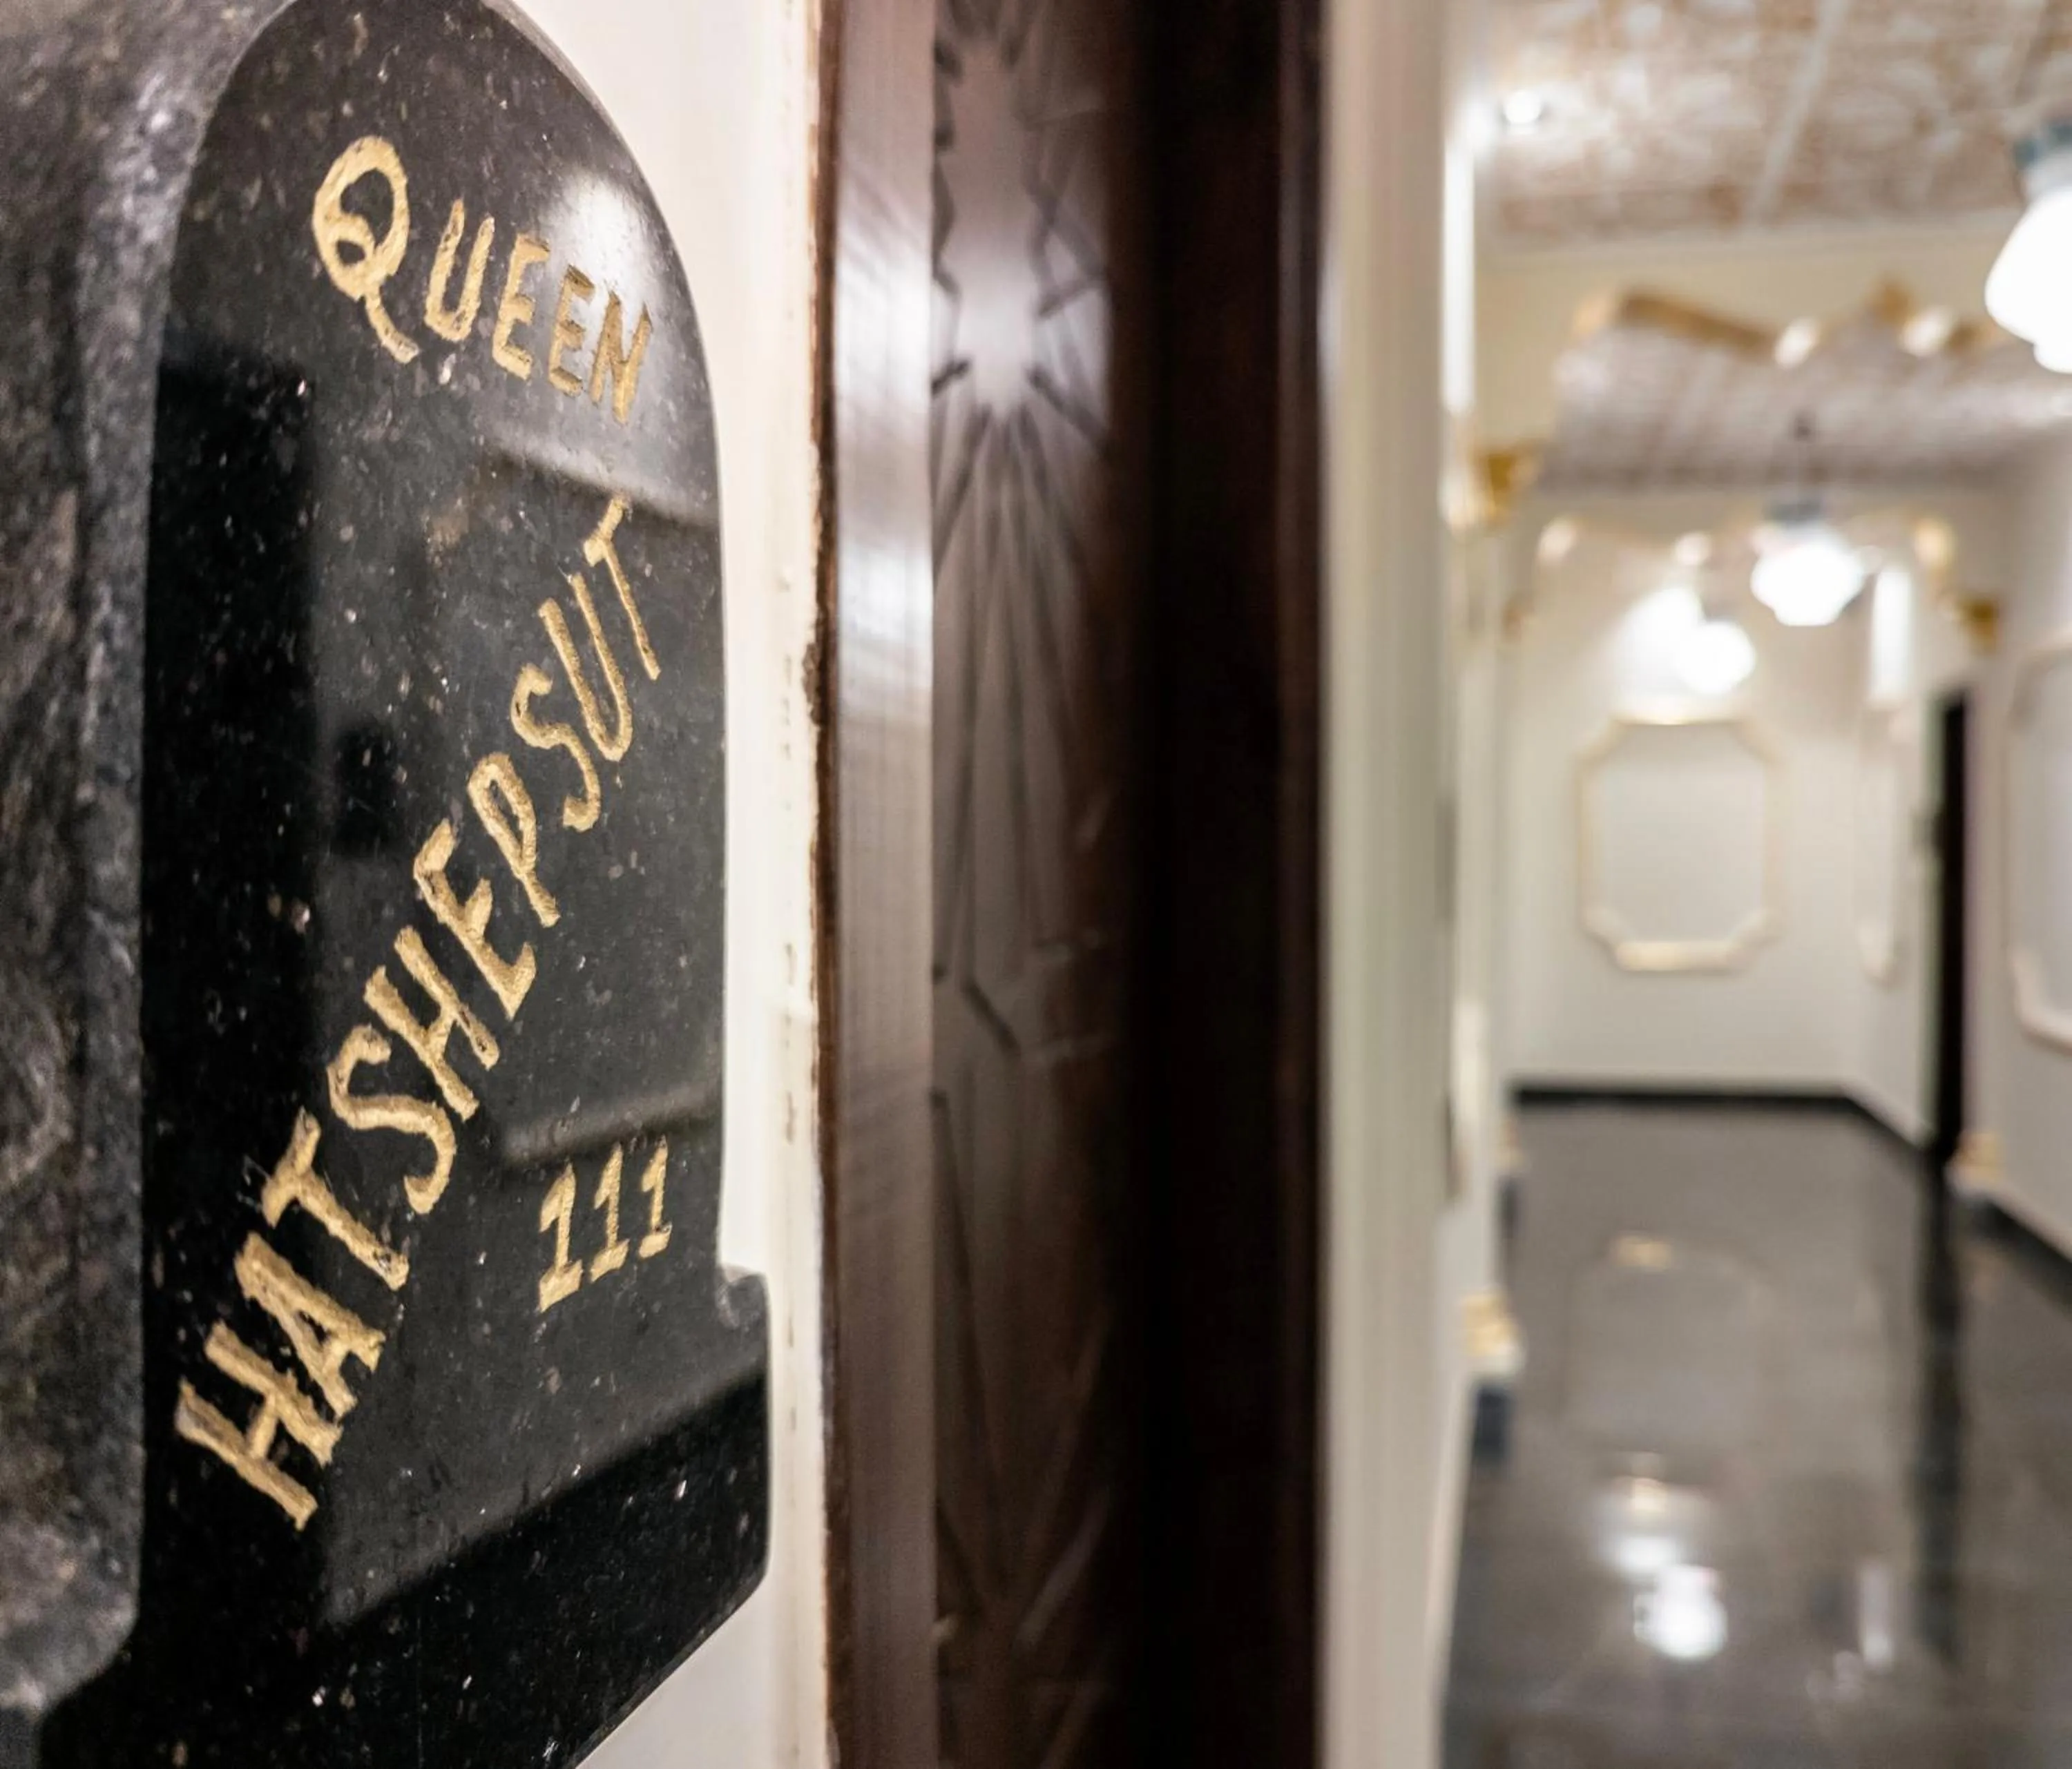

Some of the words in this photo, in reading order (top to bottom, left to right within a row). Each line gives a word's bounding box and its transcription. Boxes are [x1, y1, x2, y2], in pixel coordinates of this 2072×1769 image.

[311, 135, 652, 424] QUEEN
[175, 493, 661, 1531] HATSHEPSUT
[537, 1134, 673, 1313] 111
